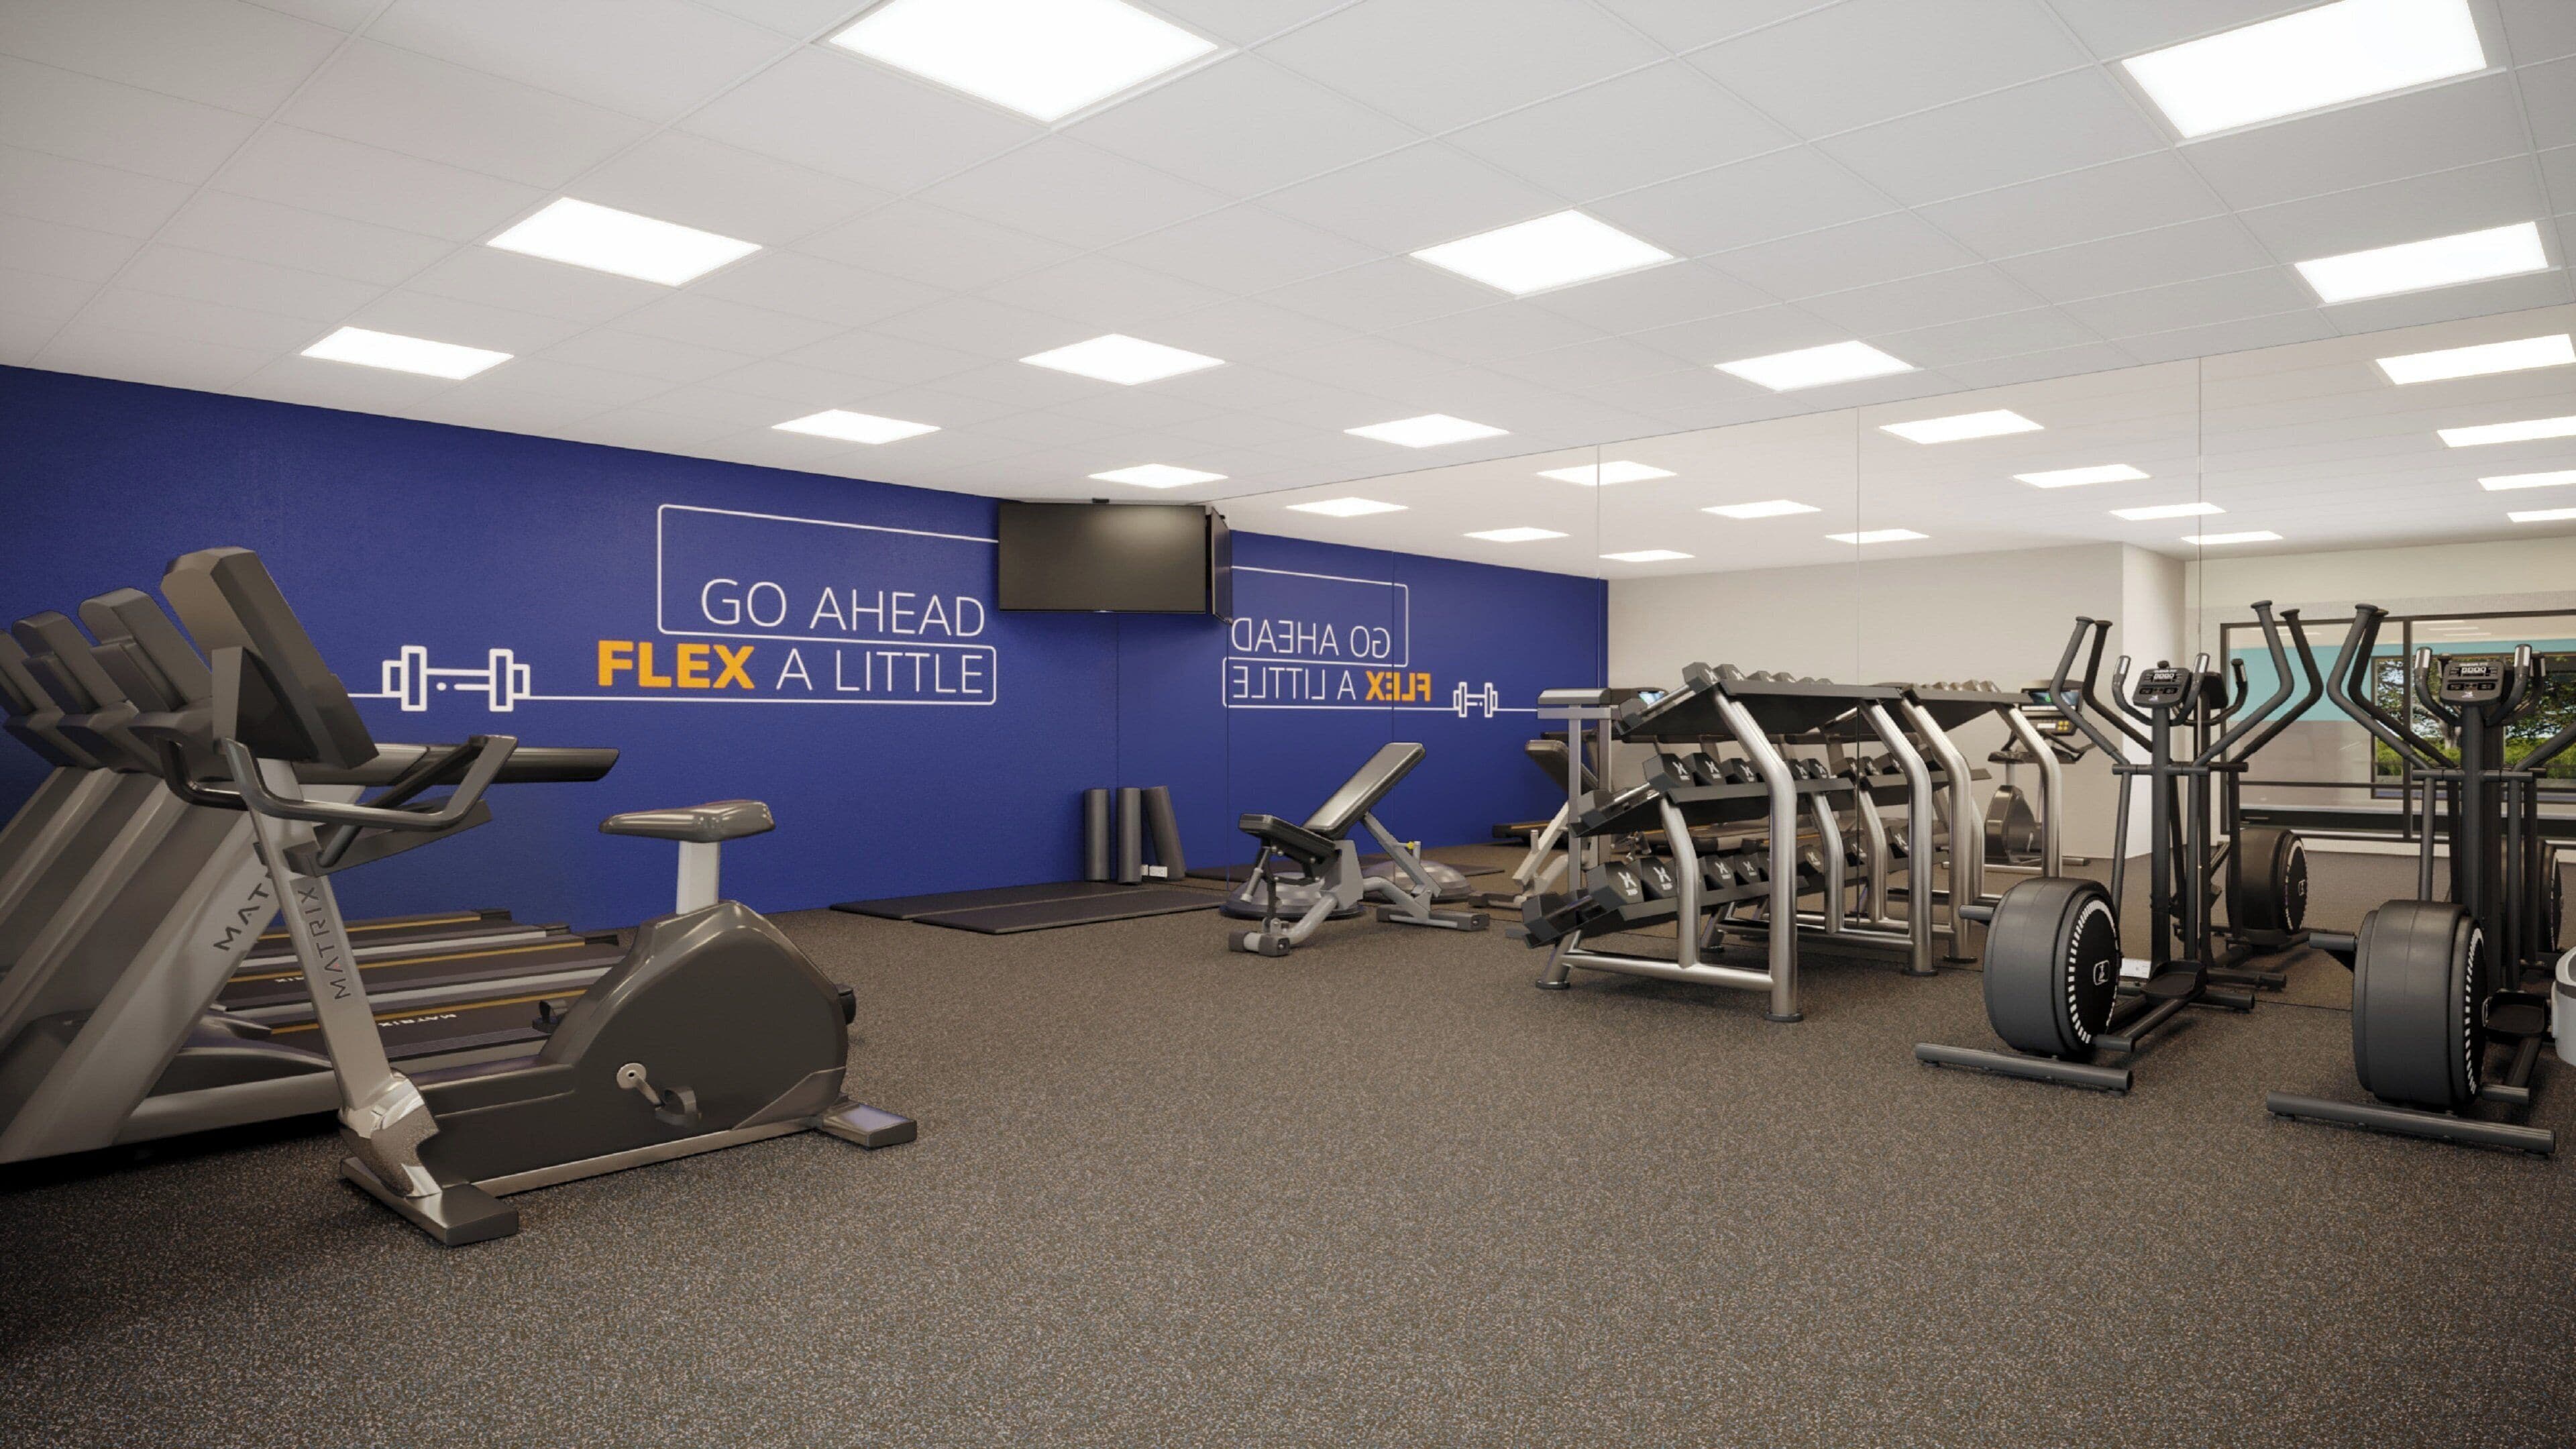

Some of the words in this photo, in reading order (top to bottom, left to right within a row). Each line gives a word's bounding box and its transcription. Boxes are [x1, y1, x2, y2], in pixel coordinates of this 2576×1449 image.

[701, 578, 787, 627] GO
[810, 587, 985, 637] AHEAD
[598, 640, 755, 690] FLEX
[776, 648, 813, 691] A
[836, 649, 983, 693] LITTLE
[213, 872, 272, 951] MAT
[297, 887, 352, 1000] MATRIX
